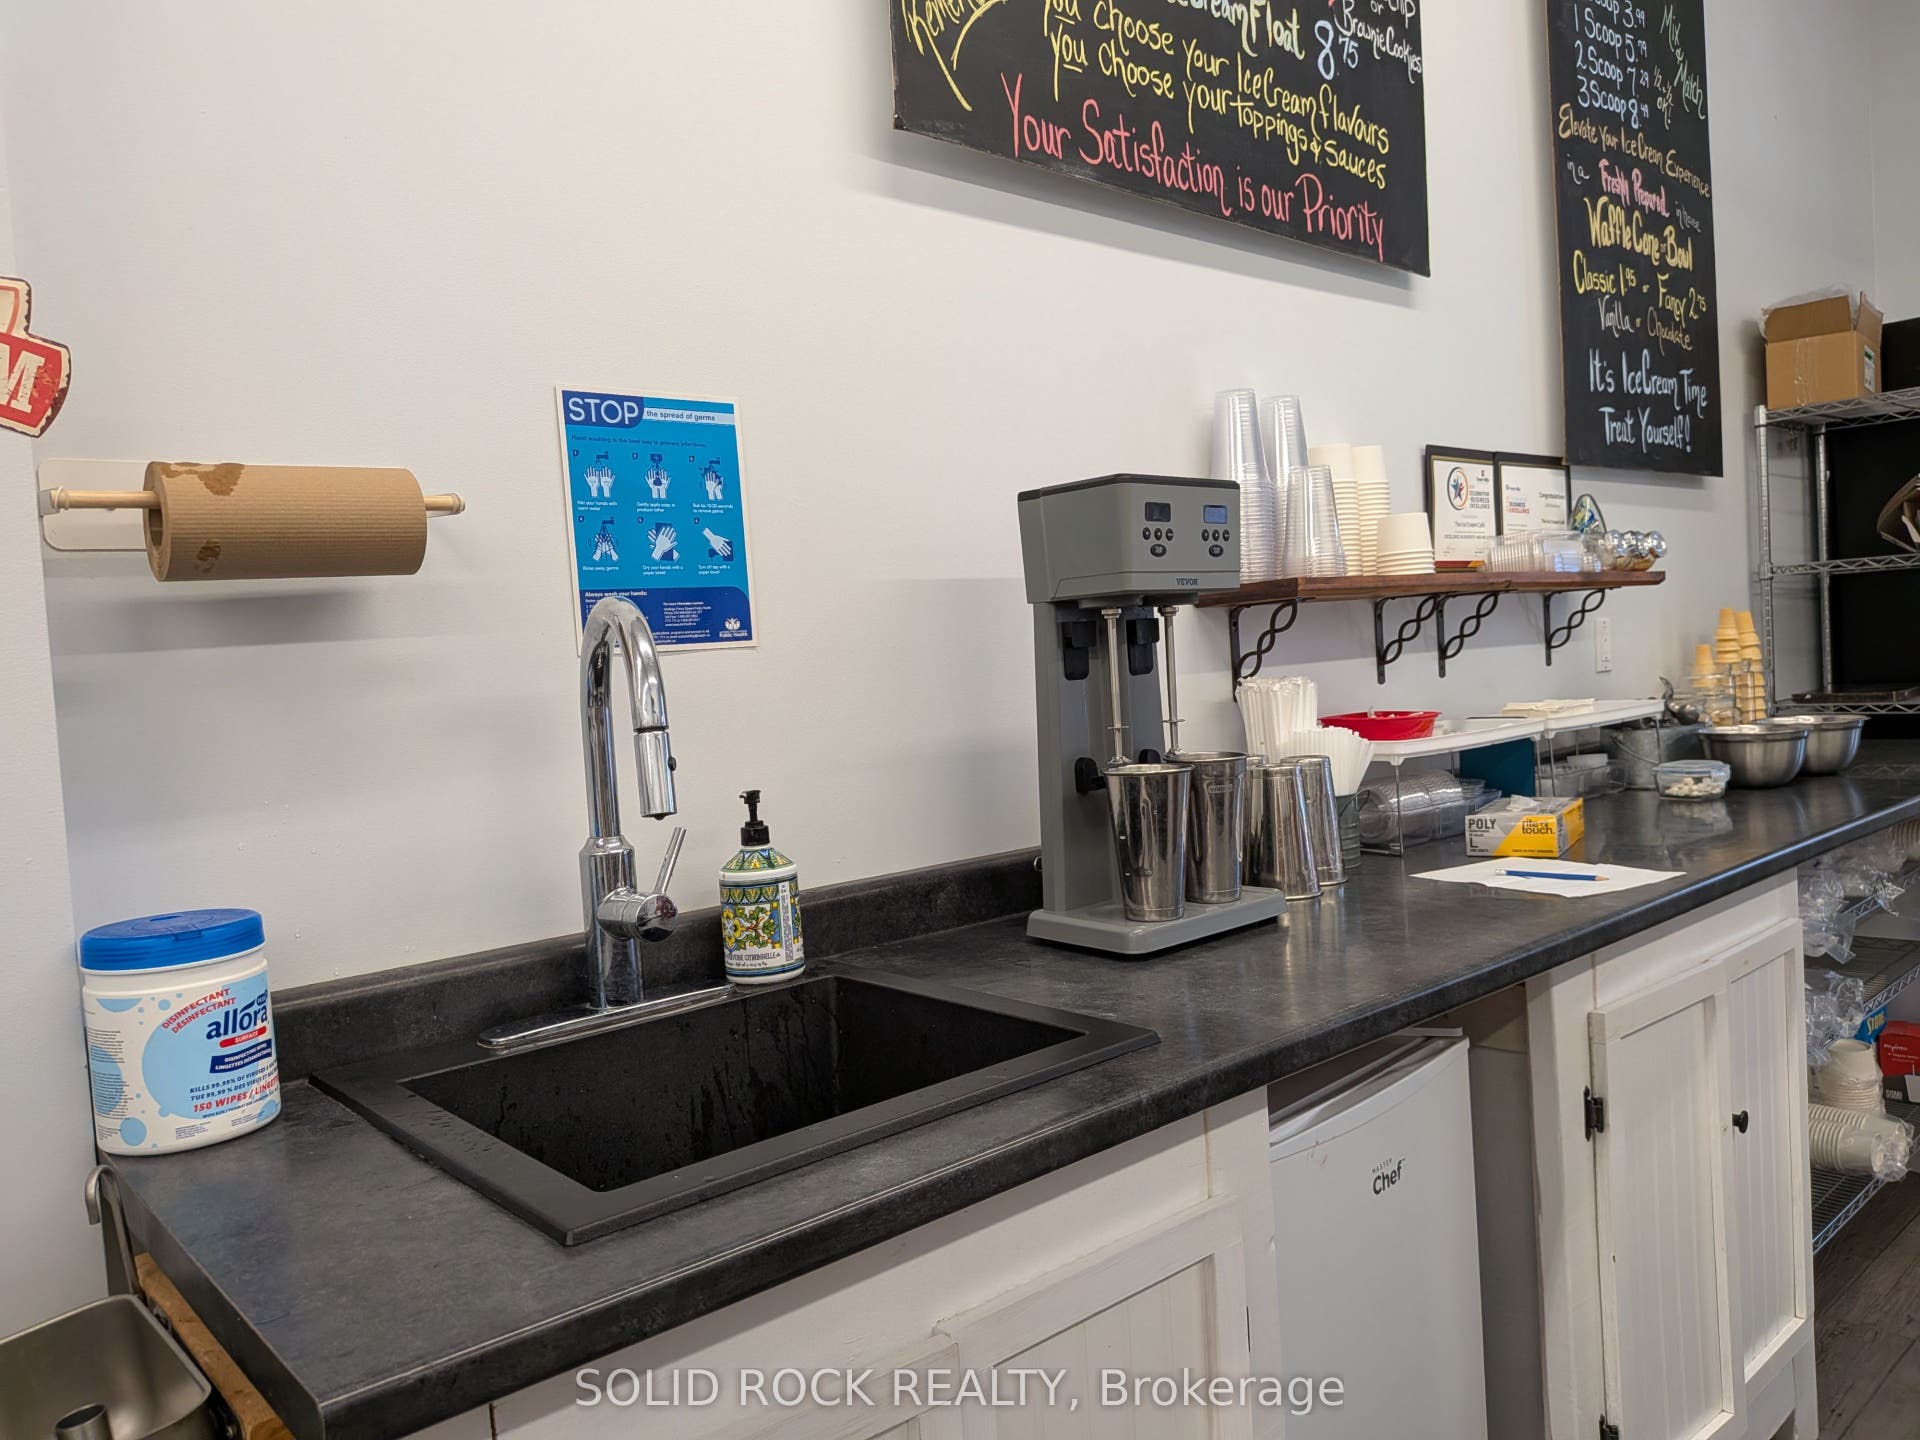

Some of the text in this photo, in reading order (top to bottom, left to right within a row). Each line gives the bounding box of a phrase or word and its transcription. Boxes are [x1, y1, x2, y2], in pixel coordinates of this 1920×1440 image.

[1574, 3, 1579, 32] 1
[1584, 7, 1622, 59] Scoop
[1660, 4, 1681, 52] Mix
[1575, 40, 1587, 69] 2
[1588, 45, 1624, 90] Scoop
[1577, 75, 1590, 107] 3
[1590, 80, 1626, 121] Scoop
[1674, 60, 1705, 119] Match
[1230, 94, 1307, 165] toppings
[1319, 83, 1389, 154] flavours
[1000, 72, 1384, 263] Your Satisfaction is our Priority
[1559, 103, 1598, 144] Elevate
[1666, 149, 1710, 197] Experience
[1567, 154, 1590, 185] in a
[1599, 159, 1670, 217] Freshly Prepared
[1584, 196, 1632, 250] Waffle
[1633, 210, 1660, 266] Cone
[1664, 225, 1693, 271] Bowl
[1573, 250, 1616, 294] Classic
[1657, 272, 1686, 328] Fancy
[1598, 295, 1634, 338] Vanilla
[1647, 306, 1693, 356] Chocolate
[1590, 348, 1615, 393] It's
[1679, 368, 1707, 419] Time
[568, 397, 639, 425] STOP
[660, 412, 684, 421] spread
[694, 414, 715, 422] germs
[1598, 406, 1691, 453] Treat Yourself!
[1468, 819, 1496, 829] POLY
[1470, 838, 1478, 848] L
[161, 988, 230, 1029] DISINFECTANT
[234, 1031, 259, 1043] SURFACE
[190, 1085, 210, 1093] KILLS
[211, 1078, 236, 1088] 99.99%
[190, 1093, 206, 1101] TUE
[234, 1082, 245, 1091] DES
[193, 1102, 212, 1112] 150
[215, 1091, 248, 1108] WIPES
[1372, 1157, 1392, 1173] MASTER
[1373, 1158, 1405, 1195] Chef
